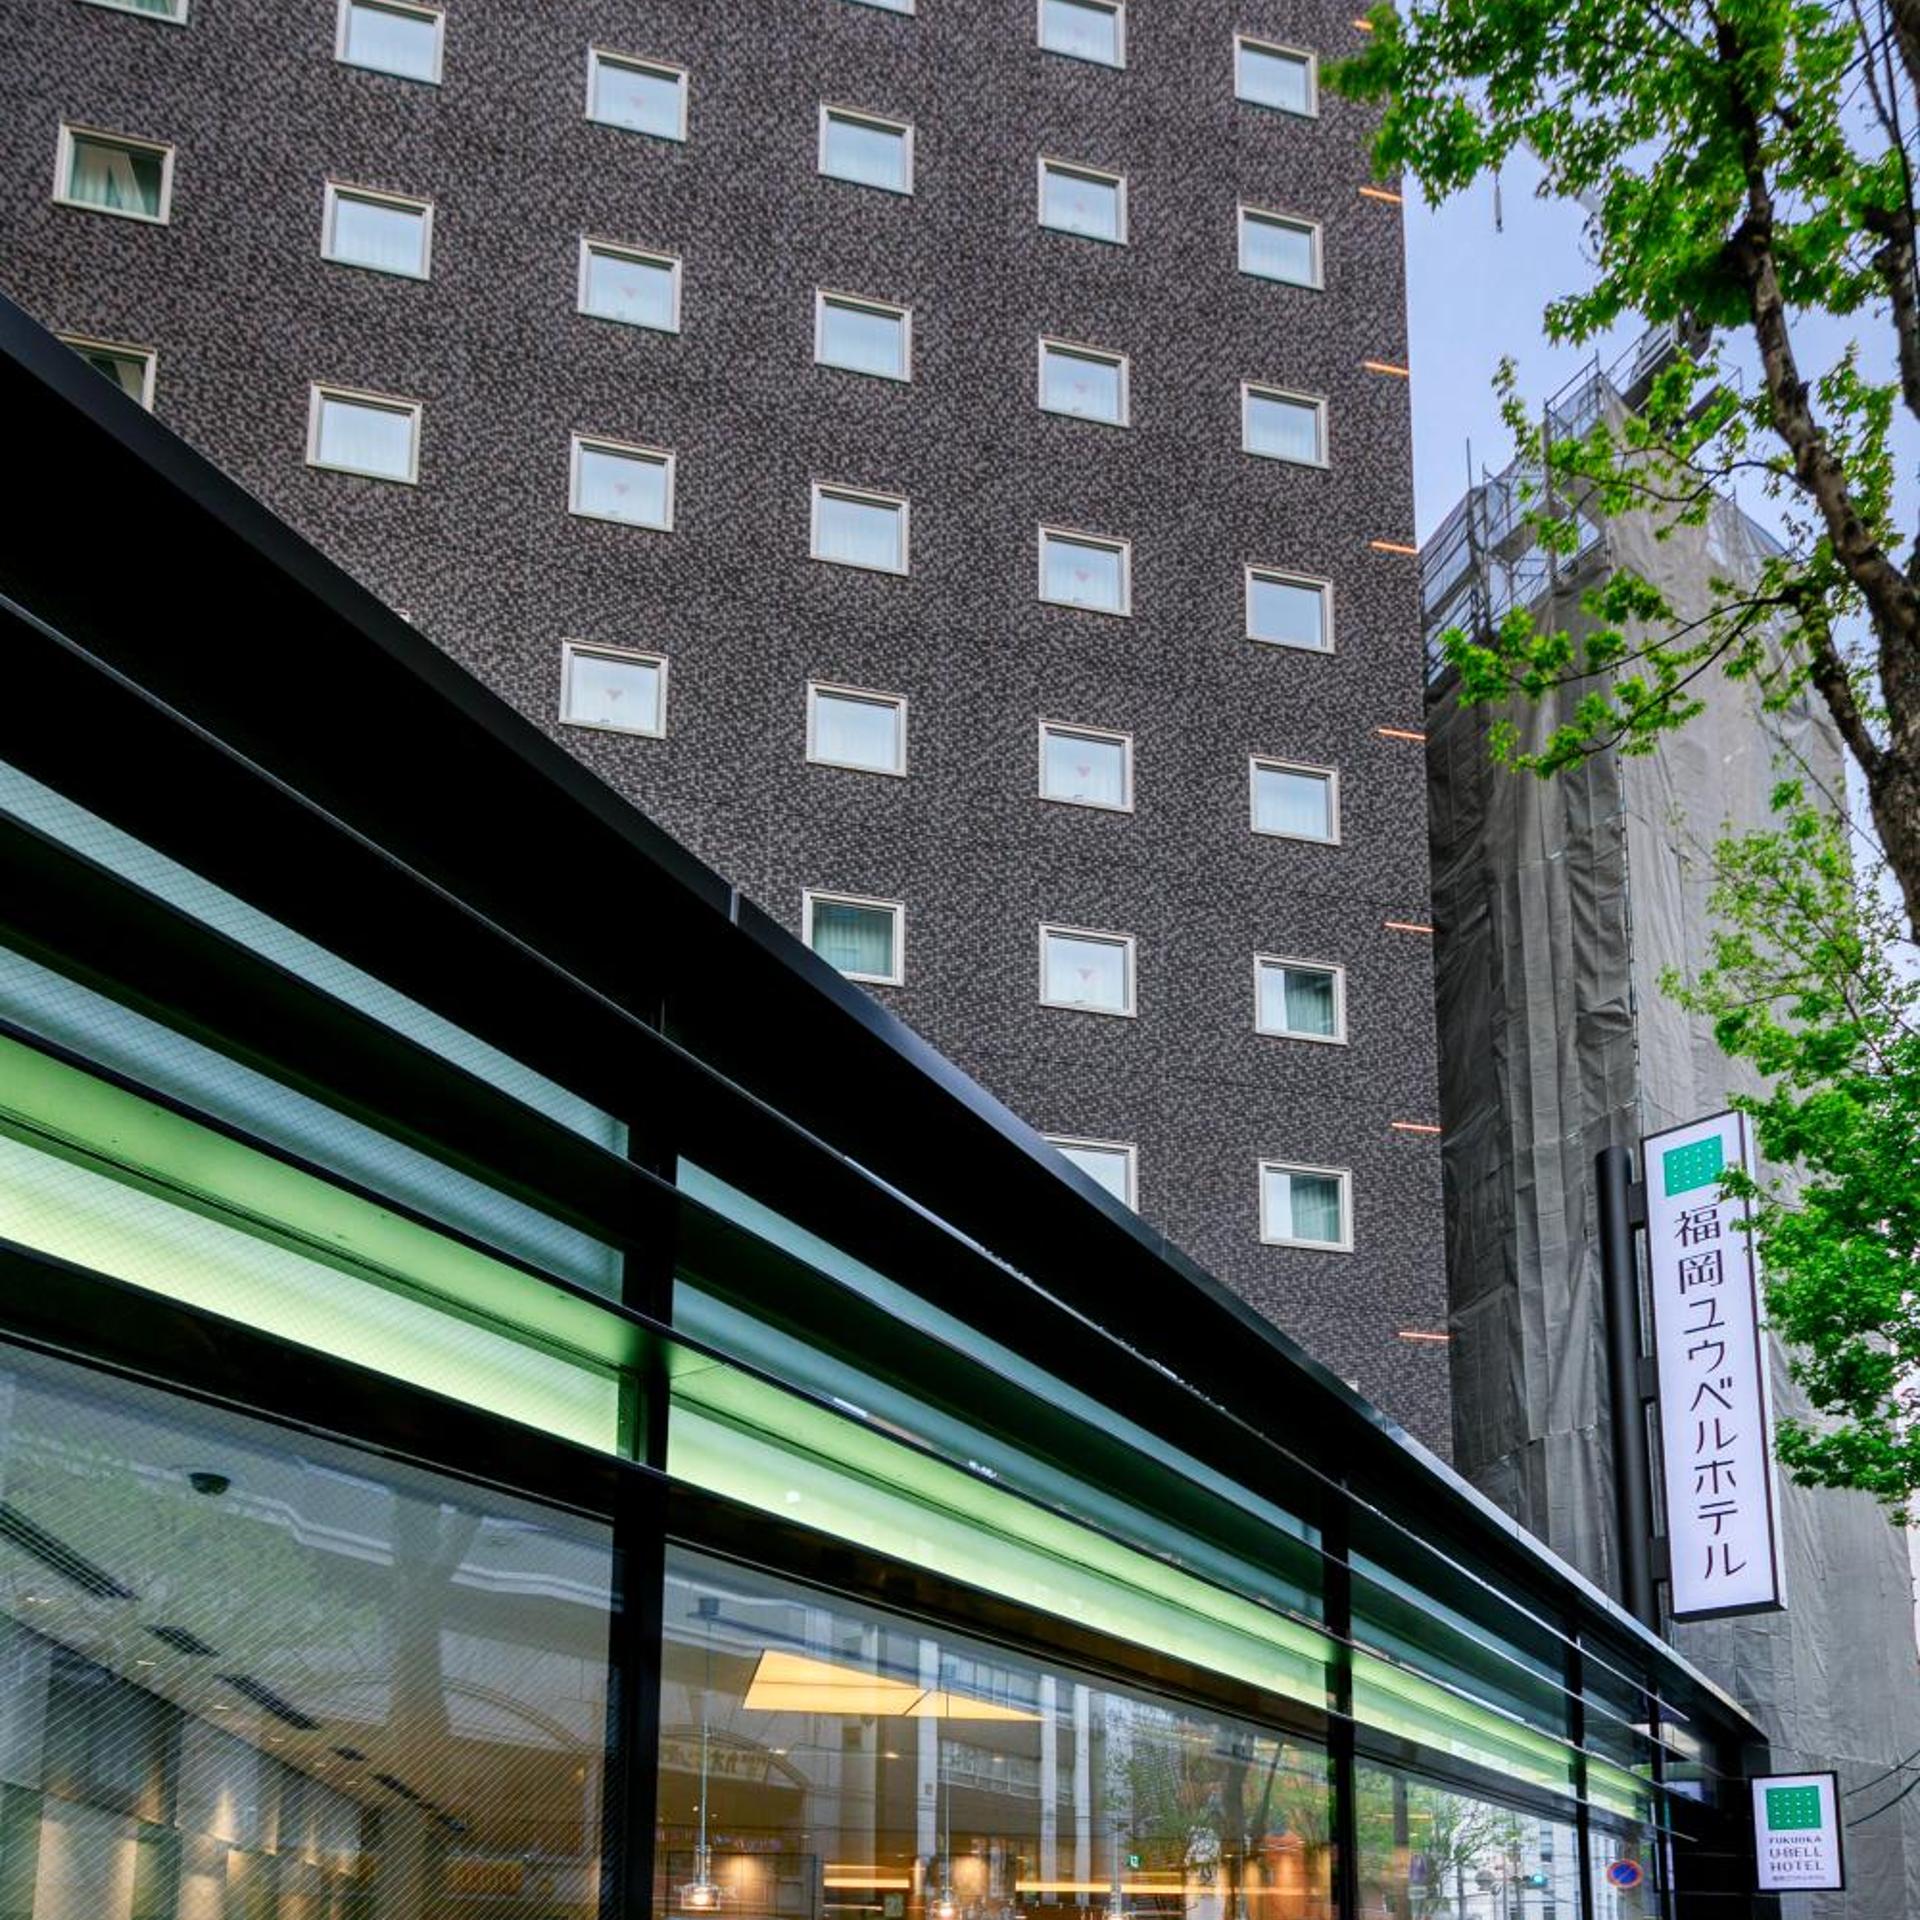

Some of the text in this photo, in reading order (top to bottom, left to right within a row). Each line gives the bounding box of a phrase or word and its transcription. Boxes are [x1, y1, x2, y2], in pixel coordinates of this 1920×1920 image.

[1673, 1203, 1746, 1579] 福岡ユウベルホテル
[1769, 1836, 1822, 1844] FUKUOKA
[1769, 1861, 1824, 1871] HOTEL
